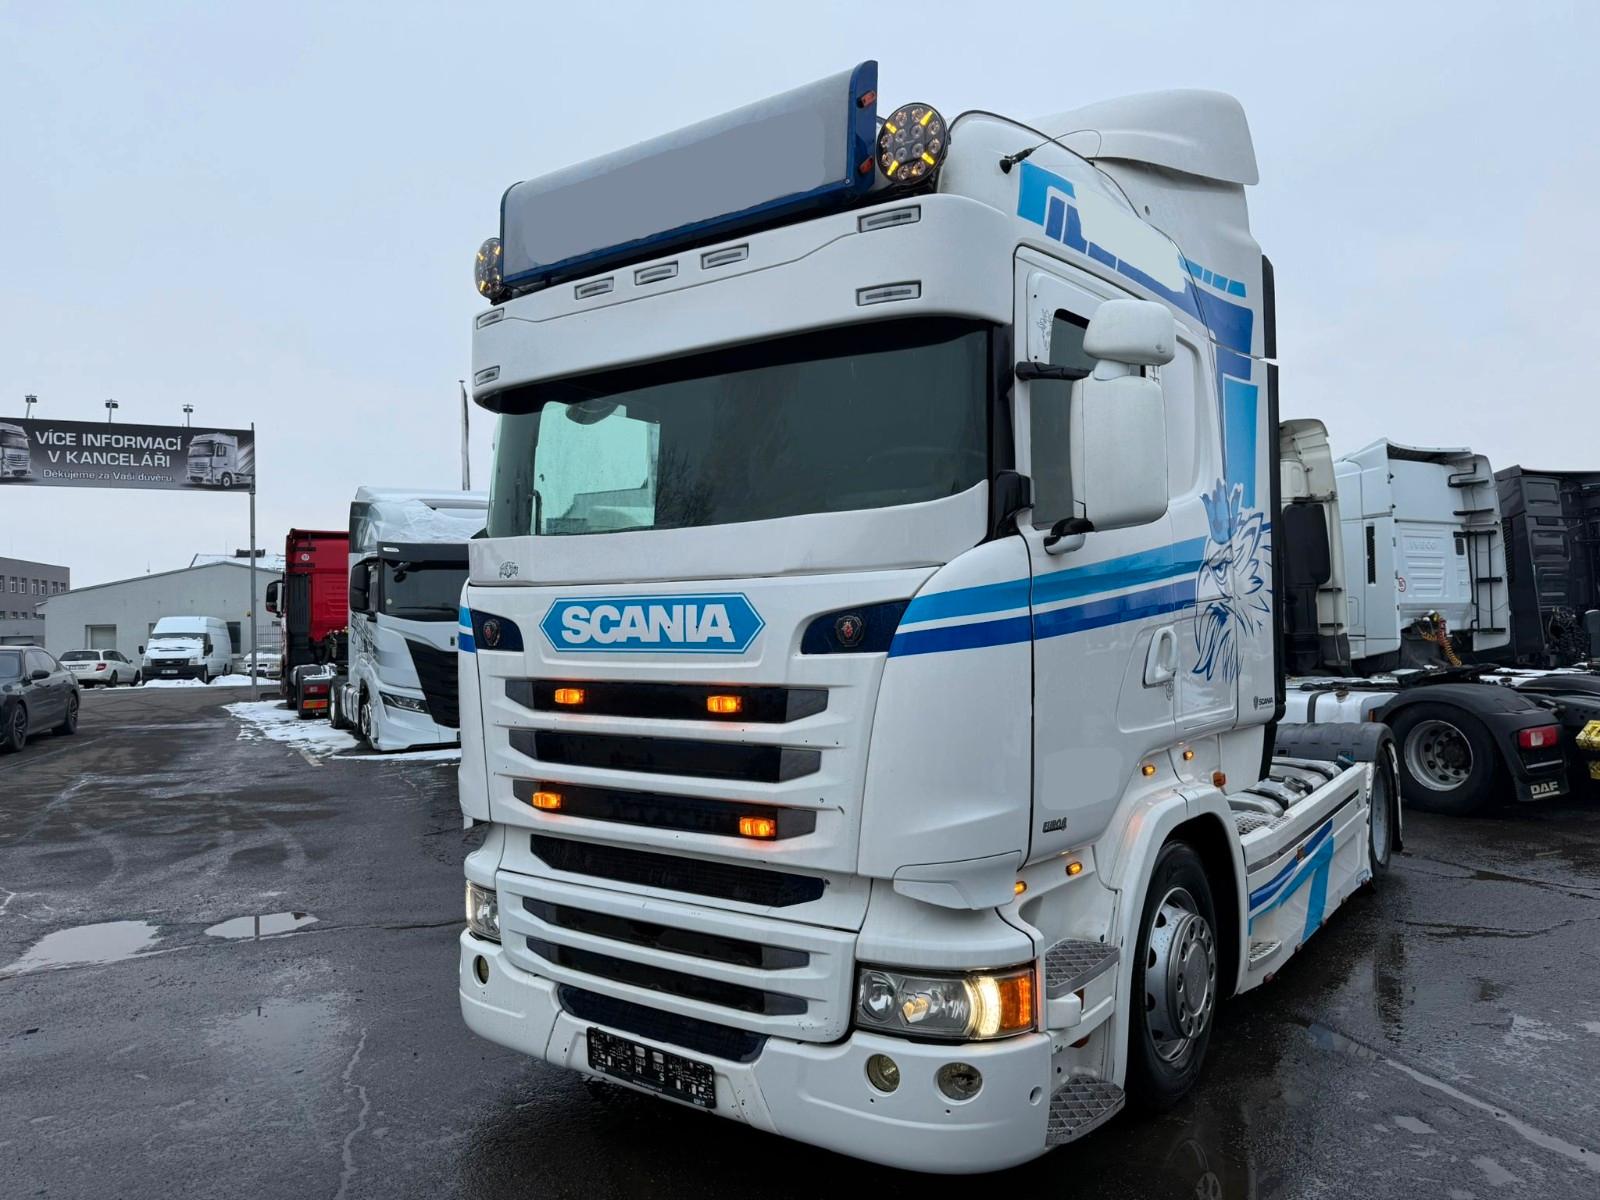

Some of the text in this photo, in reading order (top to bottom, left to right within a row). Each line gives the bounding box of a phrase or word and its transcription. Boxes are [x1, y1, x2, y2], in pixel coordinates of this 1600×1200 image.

[36, 429, 182, 451] VÍCE INFORMACÍ
[48, 450, 170, 467] V KANCELÁŘI
[99, 472, 110, 480] za
[561, 604, 736, 644] SCANIA
[1530, 781, 1559, 795] DAF
